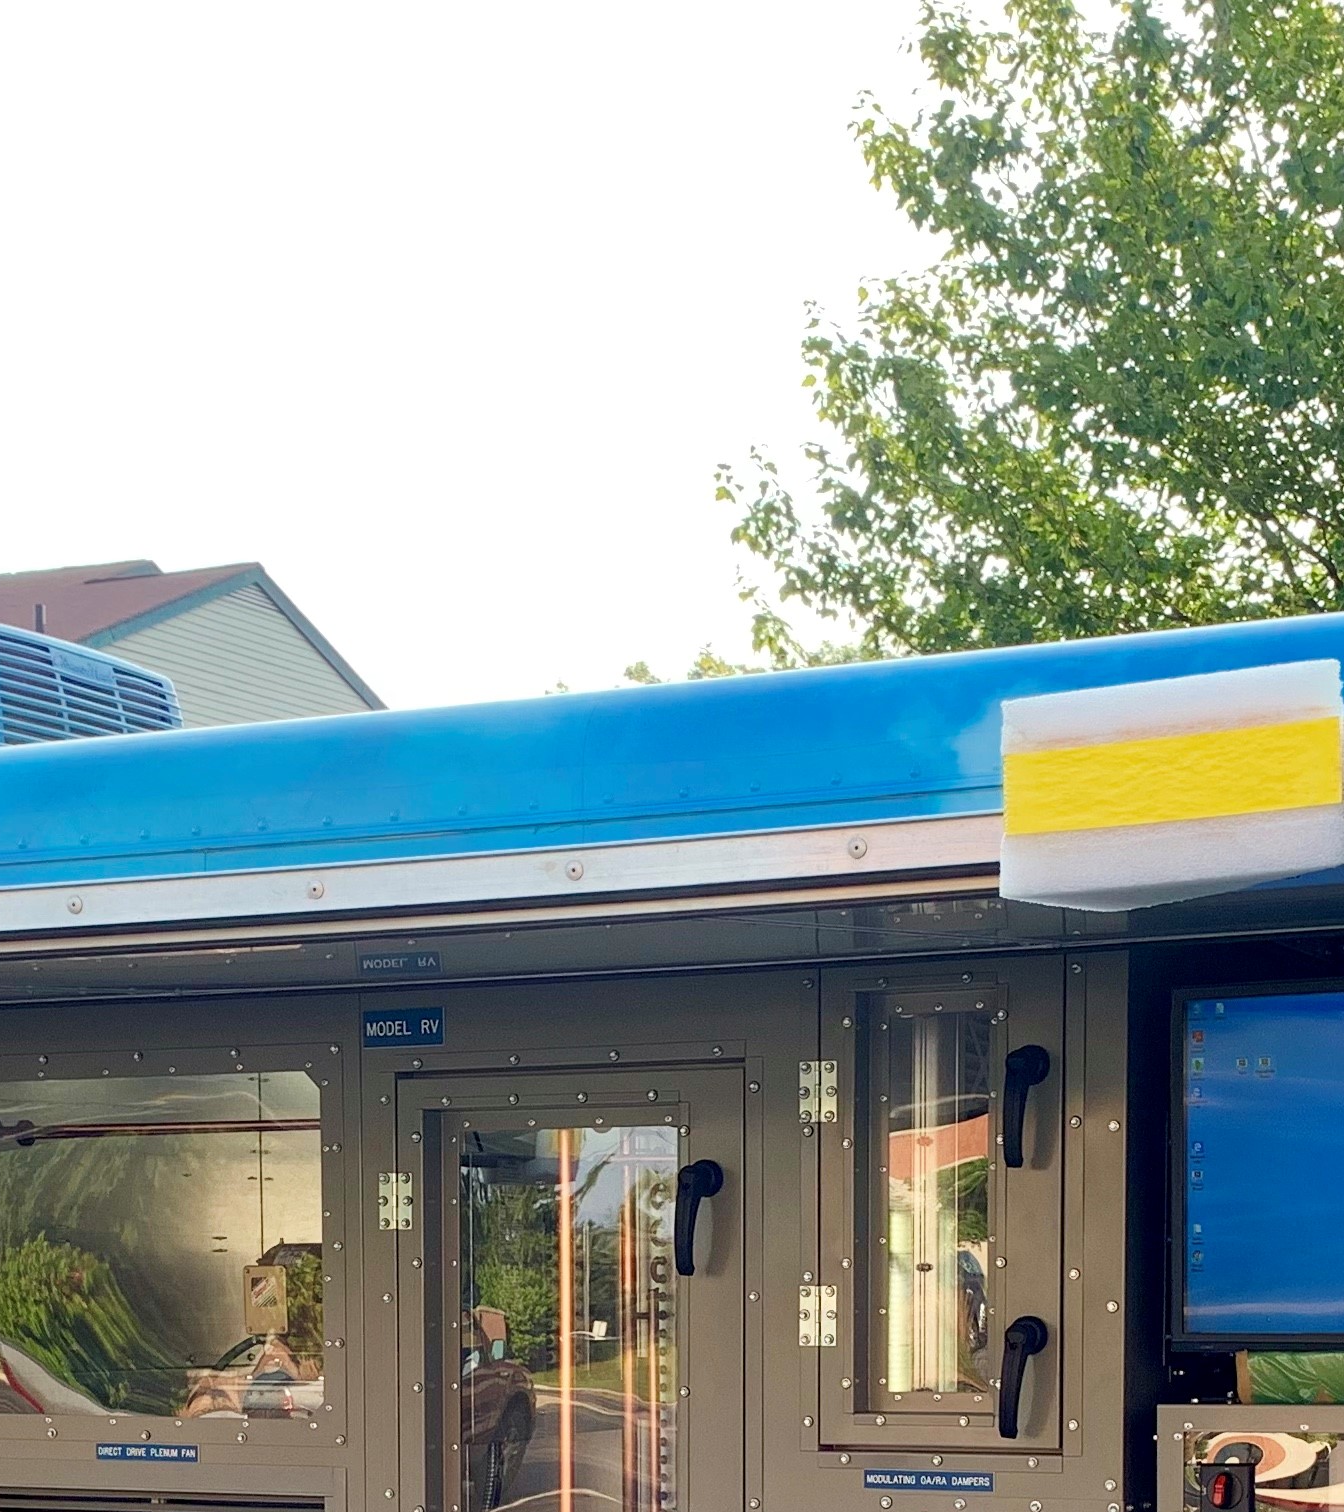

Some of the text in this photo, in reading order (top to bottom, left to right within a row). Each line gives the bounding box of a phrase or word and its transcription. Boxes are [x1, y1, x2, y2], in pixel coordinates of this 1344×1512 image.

[366, 1020, 439, 1037] MODEL RV
[98, 1446, 196, 1458] DIRECT DRIVE PLENUM FAN
[866, 1475, 990, 1486] MODULATING OA/RA DAMPERS
